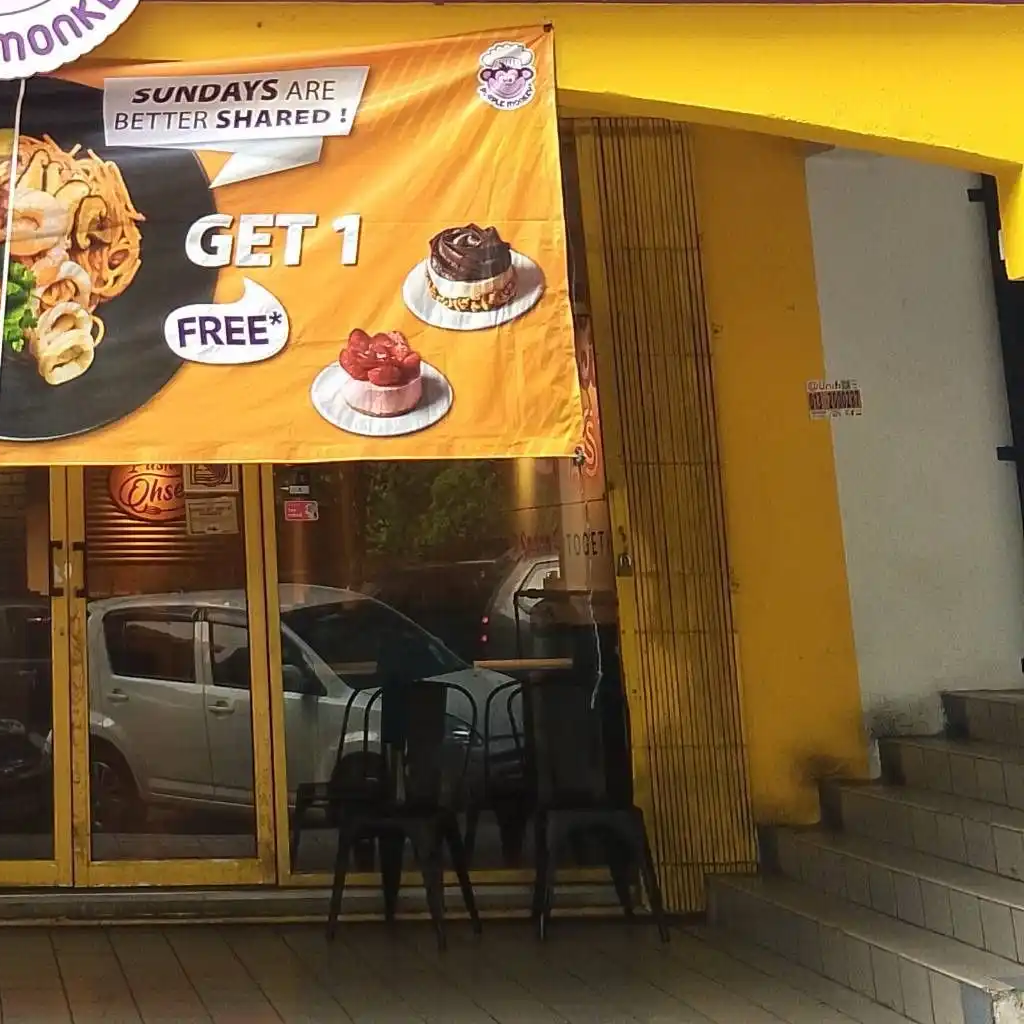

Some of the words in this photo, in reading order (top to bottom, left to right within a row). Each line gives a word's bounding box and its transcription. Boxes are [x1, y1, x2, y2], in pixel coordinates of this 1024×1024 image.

[132, 78, 278, 103] SUNDAYS
[286, 80, 336, 100] ARE
[114, 111, 208, 130] BETTER
[215, 108, 331, 129] SHARED
[185, 213, 319, 268] GET
[332, 213, 362, 266] 1
[120, 478, 184, 506] Ohse
[566, 531, 609, 556] TOGET
